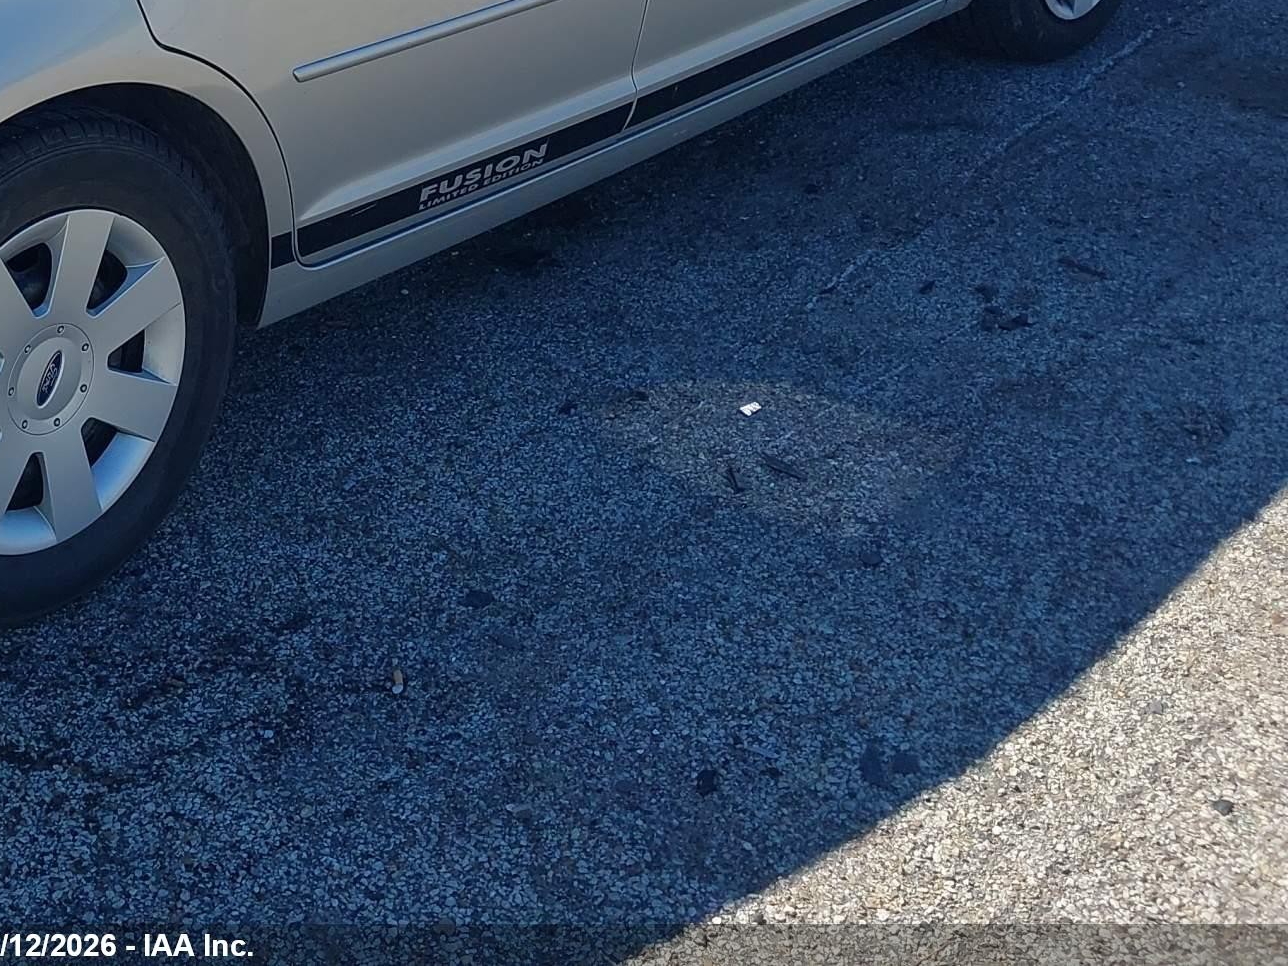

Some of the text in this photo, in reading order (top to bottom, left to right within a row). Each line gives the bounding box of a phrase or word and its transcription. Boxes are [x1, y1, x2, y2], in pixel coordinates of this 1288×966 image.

[418, 158, 544, 211] LIMITED EDITION
[419, 142, 549, 202] FUSION
